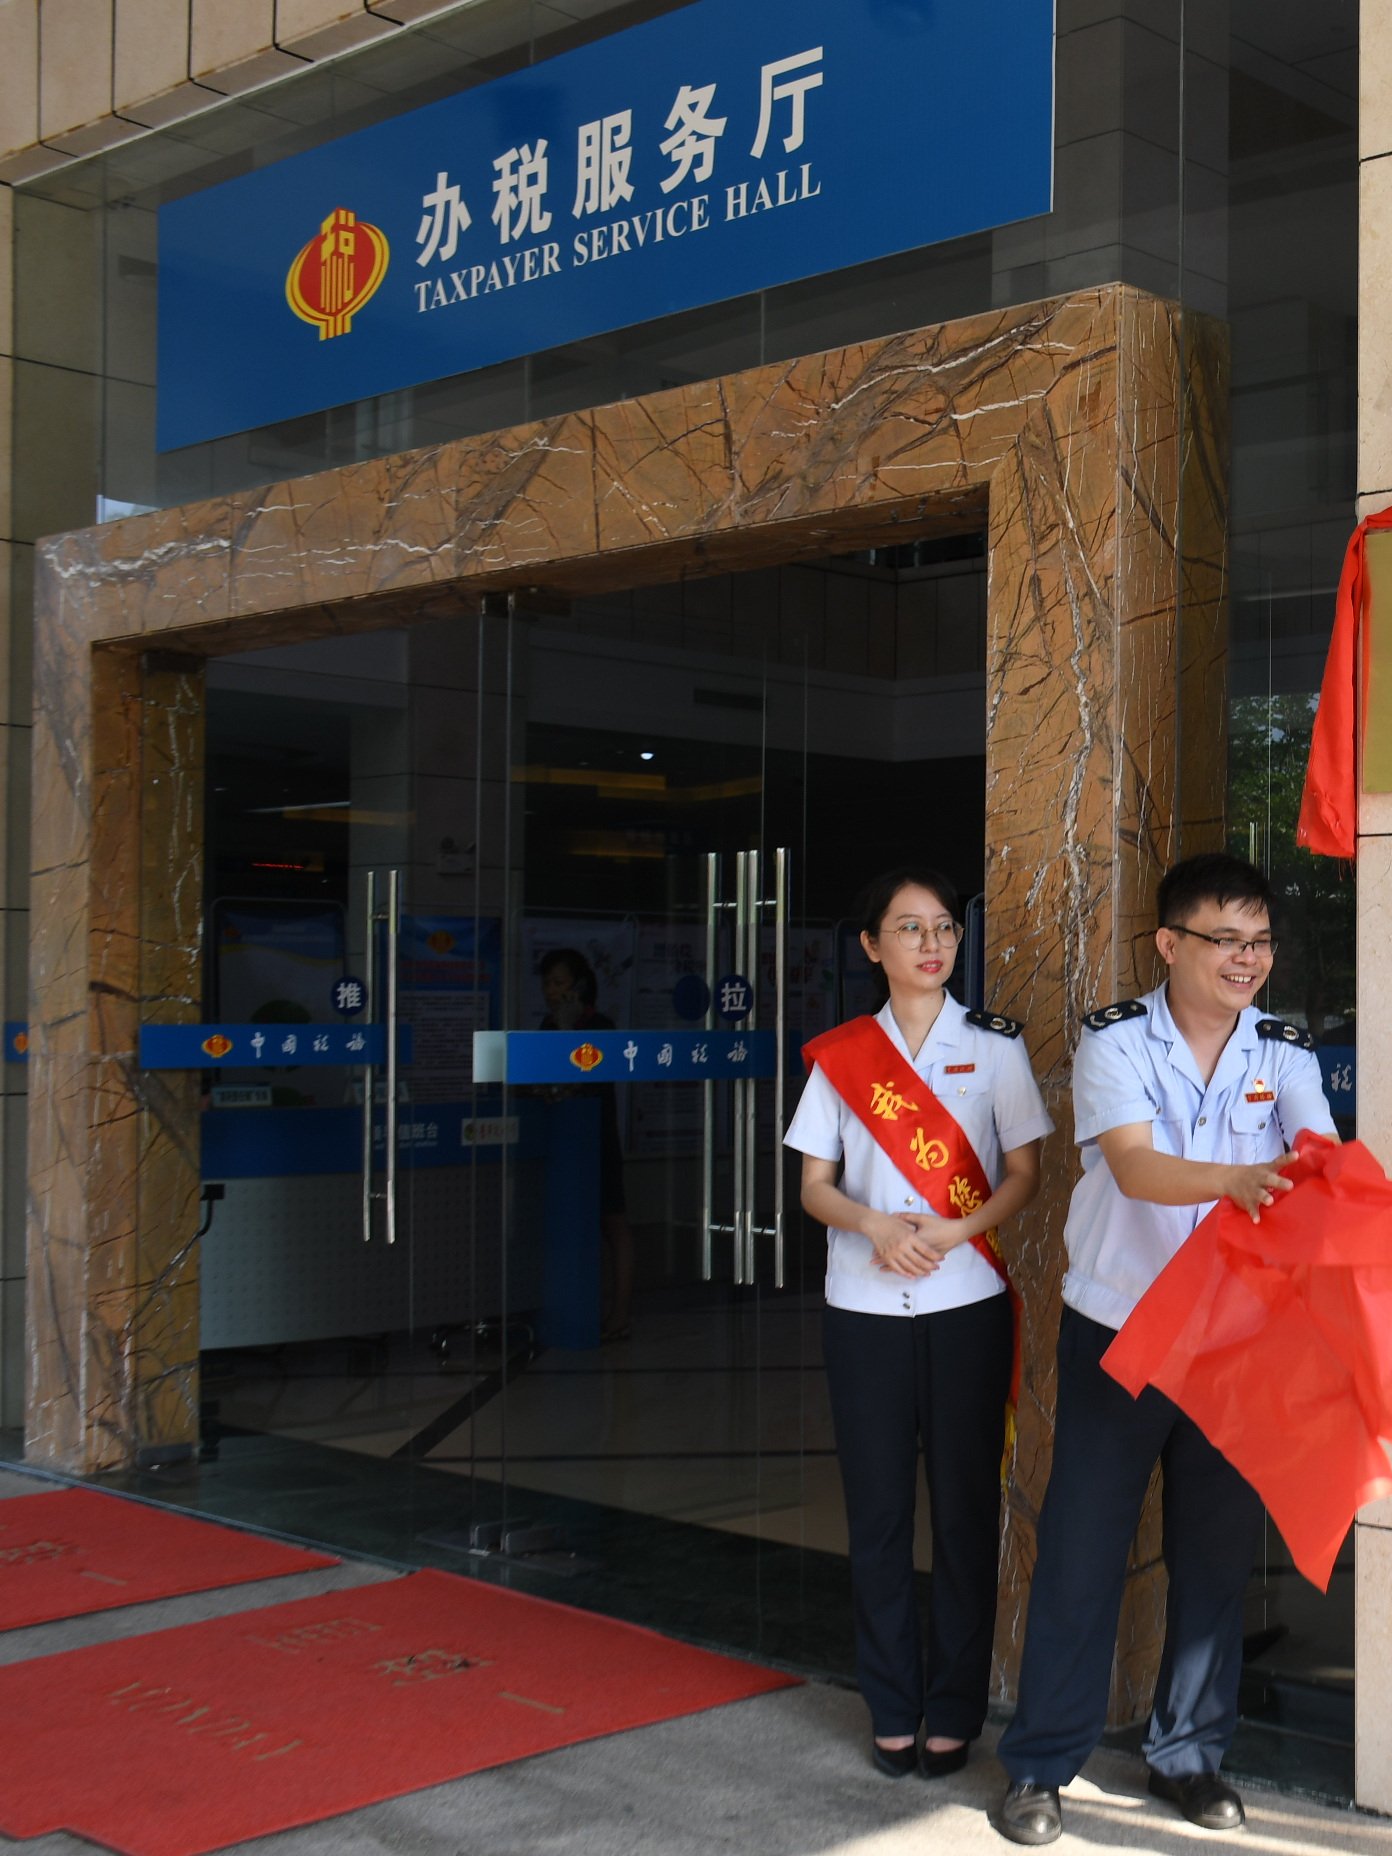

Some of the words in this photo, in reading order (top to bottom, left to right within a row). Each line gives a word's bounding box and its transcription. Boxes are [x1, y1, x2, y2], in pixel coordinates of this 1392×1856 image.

[415, 46, 824, 267] 办税服务厅
[413, 243, 562, 314] TAXPAYER
[572, 194, 709, 268] SERVICE
[722, 161, 822, 221] HALL
[336, 982, 364, 1010] 推
[720, 982, 749, 1013] 拉
